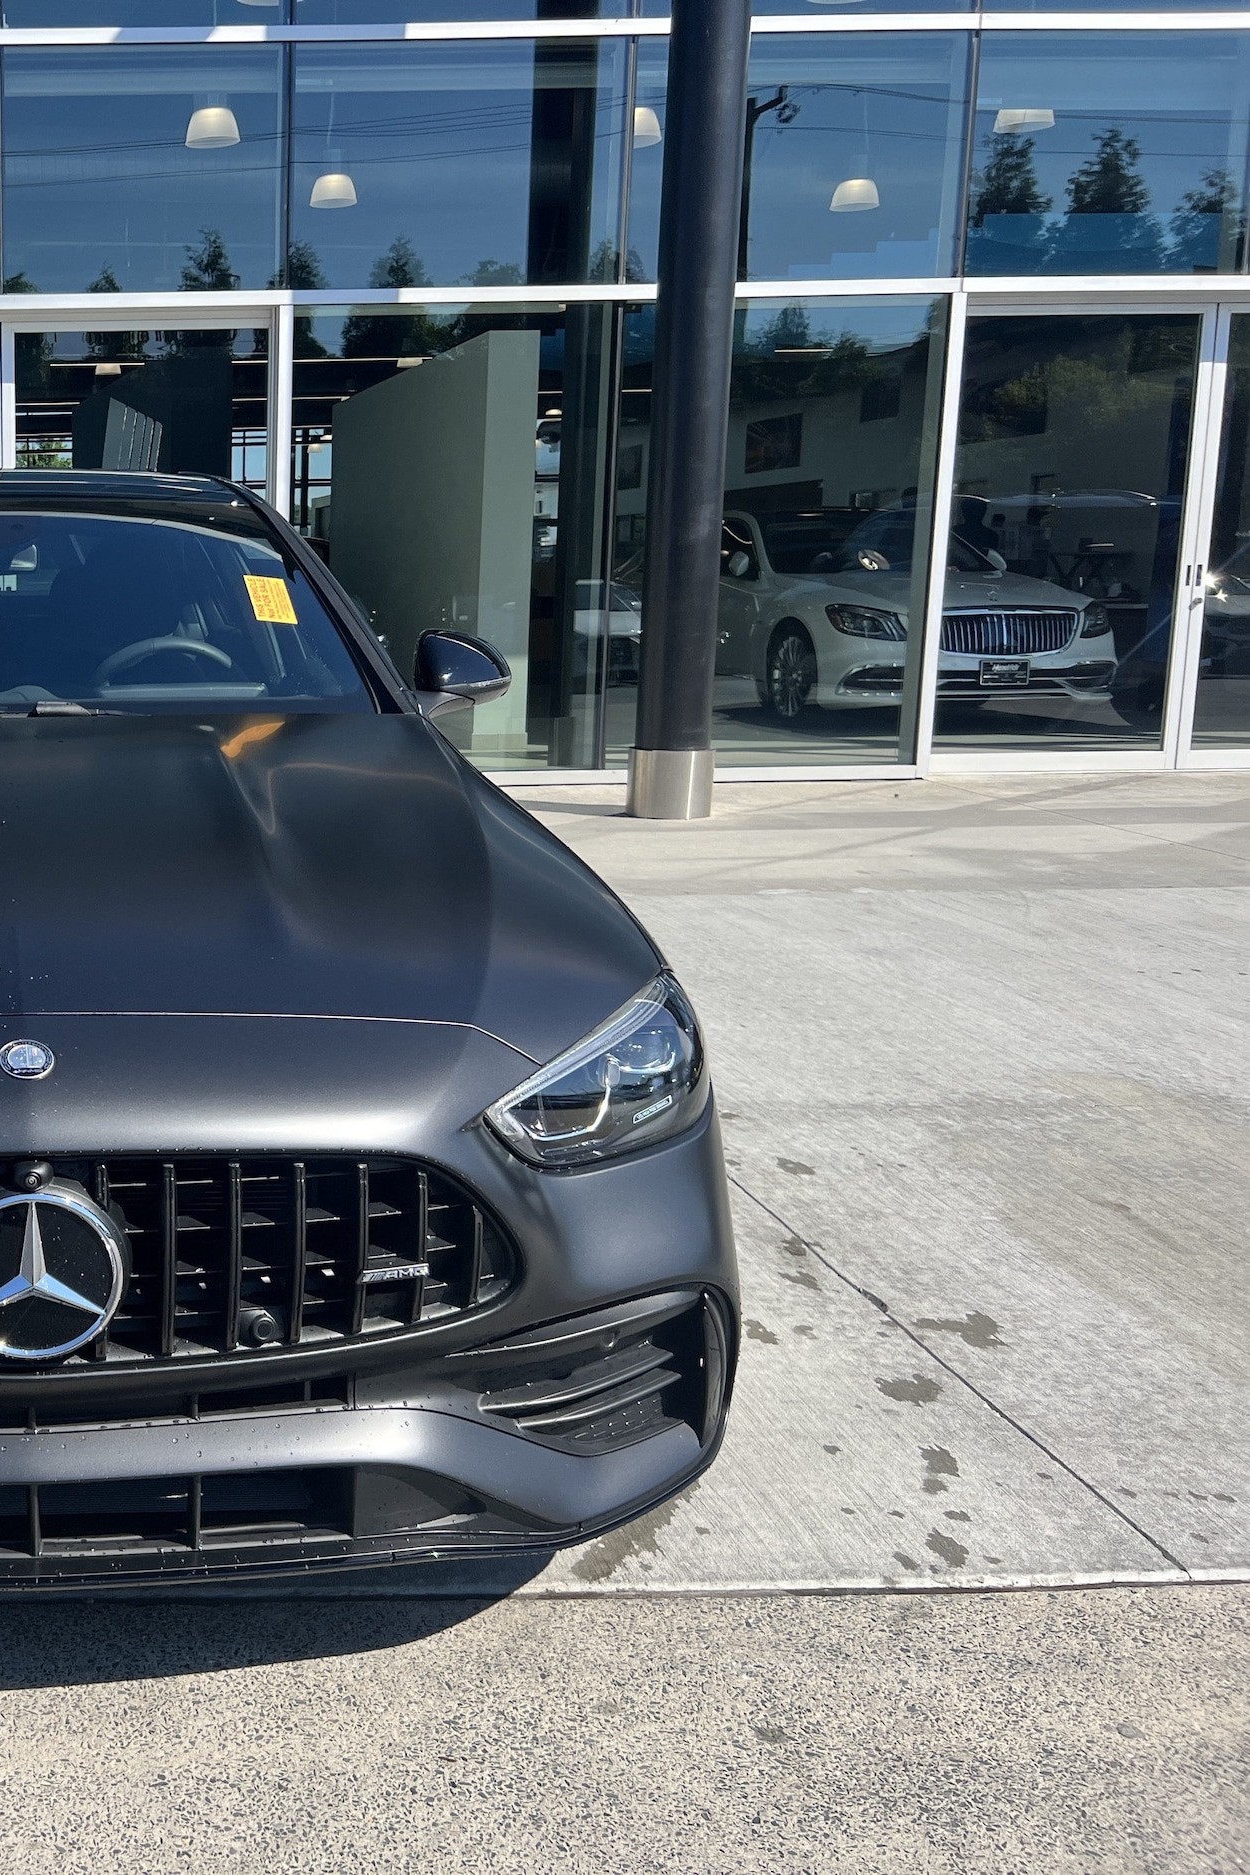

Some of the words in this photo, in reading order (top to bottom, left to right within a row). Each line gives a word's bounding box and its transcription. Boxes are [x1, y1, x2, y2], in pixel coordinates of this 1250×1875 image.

[247, 578, 261, 602] VEHICLE
[256, 579, 268, 593] SALE
[262, 594, 271, 607] FOR
[256, 604, 265, 617] THIS
[383, 1266, 429, 1280] AMG
